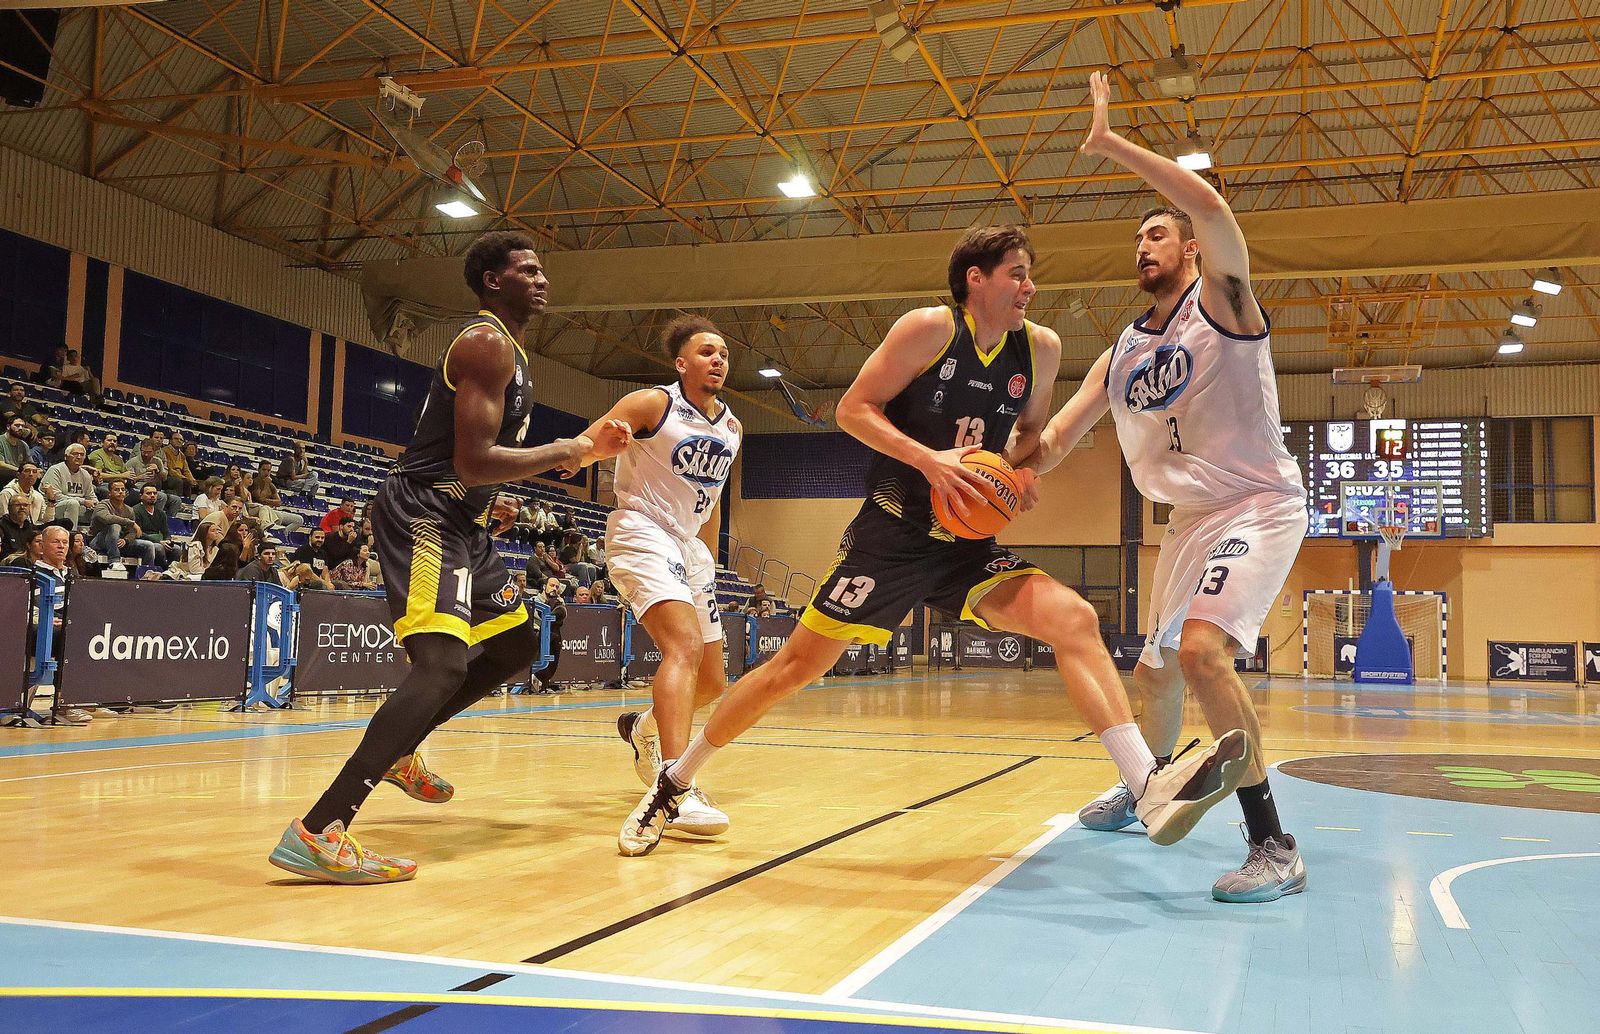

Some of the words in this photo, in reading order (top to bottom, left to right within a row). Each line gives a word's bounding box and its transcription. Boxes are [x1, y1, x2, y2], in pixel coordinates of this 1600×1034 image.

[954, 416, 985, 447] 13
[696, 439, 712, 453] LA
[1385, 440, 1403, 455] 12
[673, 445, 731, 480] SALUD
[1325, 461, 1355, 478] 36
[1373, 460, 1404, 478] 35
[1360, 506, 1369, 516] 2
[828, 575, 876, 609] 13
[88, 622, 229, 660] damex.io
[561, 635, 588, 654] surpool
[758, 636, 789, 649] CENTRA
[328, 652, 394, 663] CENTER
[594, 648, 615, 659] LABOR
